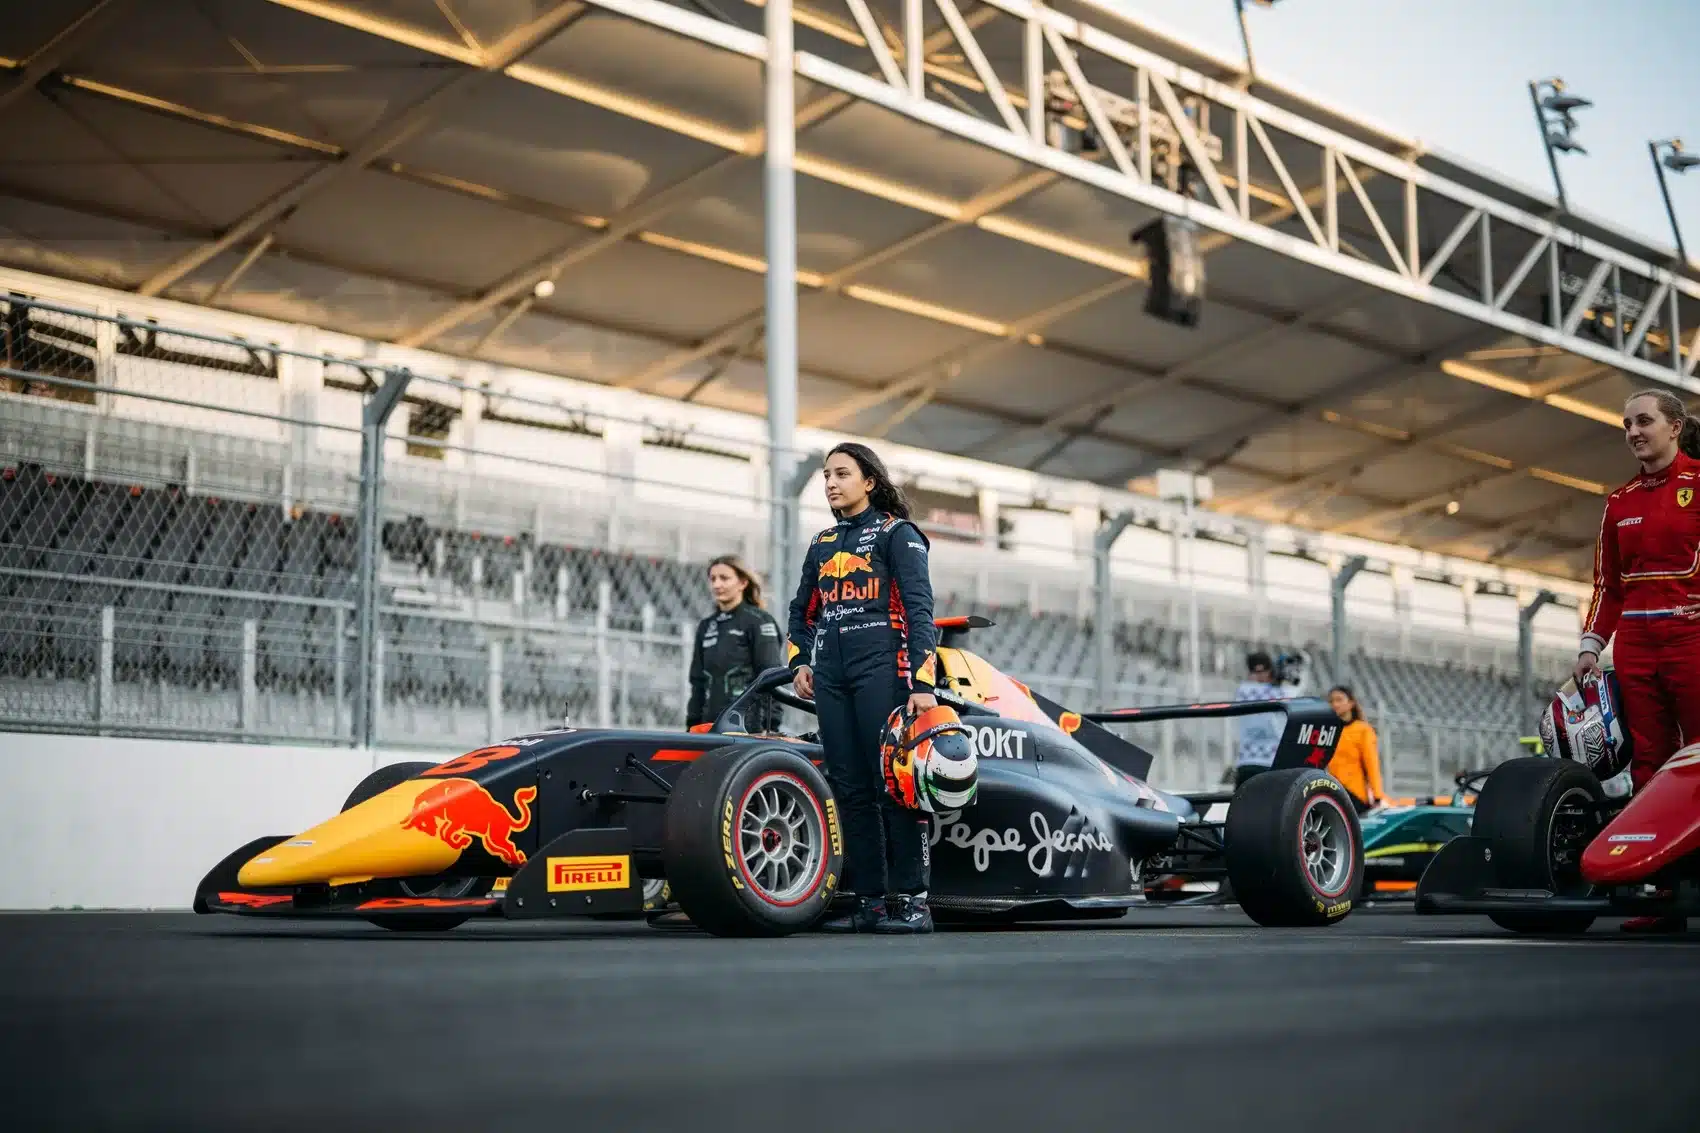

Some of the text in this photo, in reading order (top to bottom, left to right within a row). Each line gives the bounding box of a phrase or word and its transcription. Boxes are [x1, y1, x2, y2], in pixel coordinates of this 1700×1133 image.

[841, 577, 879, 600] Bull
[962, 724, 1028, 760] ROKT
[1297, 723, 1336, 747] Mobil
[1310, 778, 1339, 791] ZERO
[825, 799, 842, 856] PIRELLI
[722, 800, 745, 889] P ZERO
[930, 810, 1114, 876] Pepe Jeans
[555, 862, 622, 884] PIRELLI
